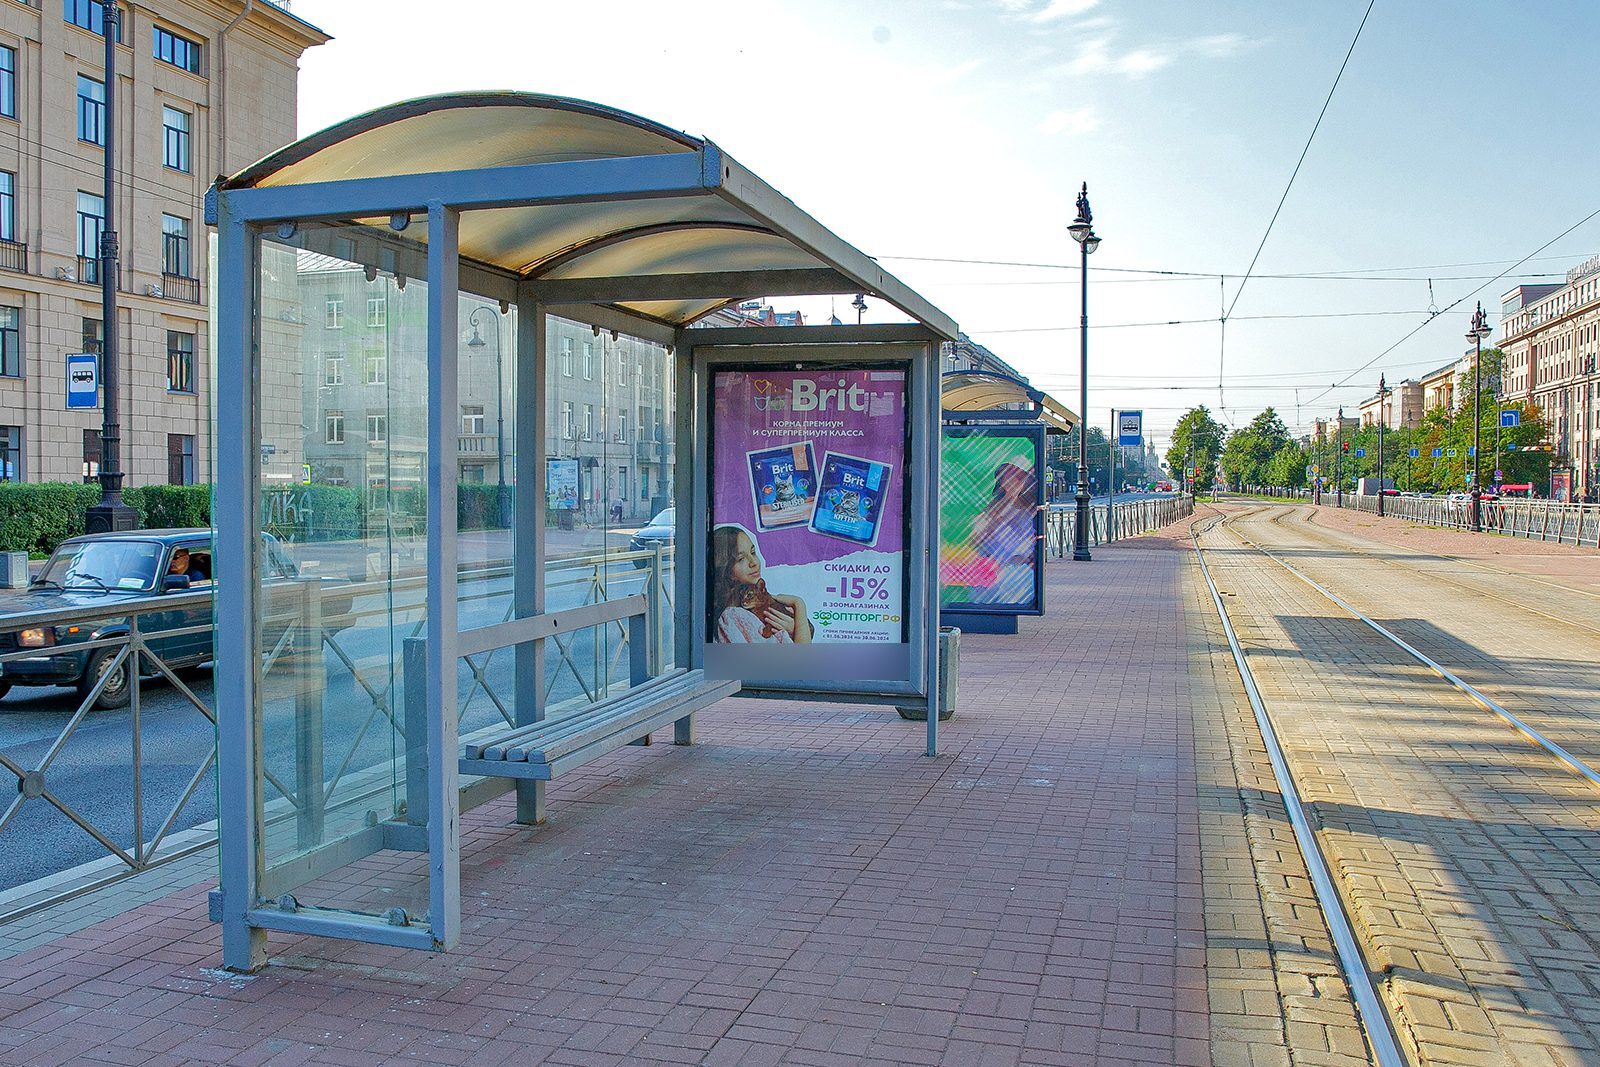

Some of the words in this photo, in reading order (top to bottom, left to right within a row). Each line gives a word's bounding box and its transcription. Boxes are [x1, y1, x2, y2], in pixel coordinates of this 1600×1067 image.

[792, 379, 865, 412] Brit
[773, 420, 802, 428] КОРМА
[761, 429, 828, 437] СУПЕРПРЕМИУМ
[829, 429, 864, 437] КЛАССА
[772, 463, 794, 475] Brit
[843, 473, 865, 487] Brit
[824, 564, 871, 573] СКИДКИ
[873, 565, 890, 574] ДО
[826, 577, 889, 600] -15%
